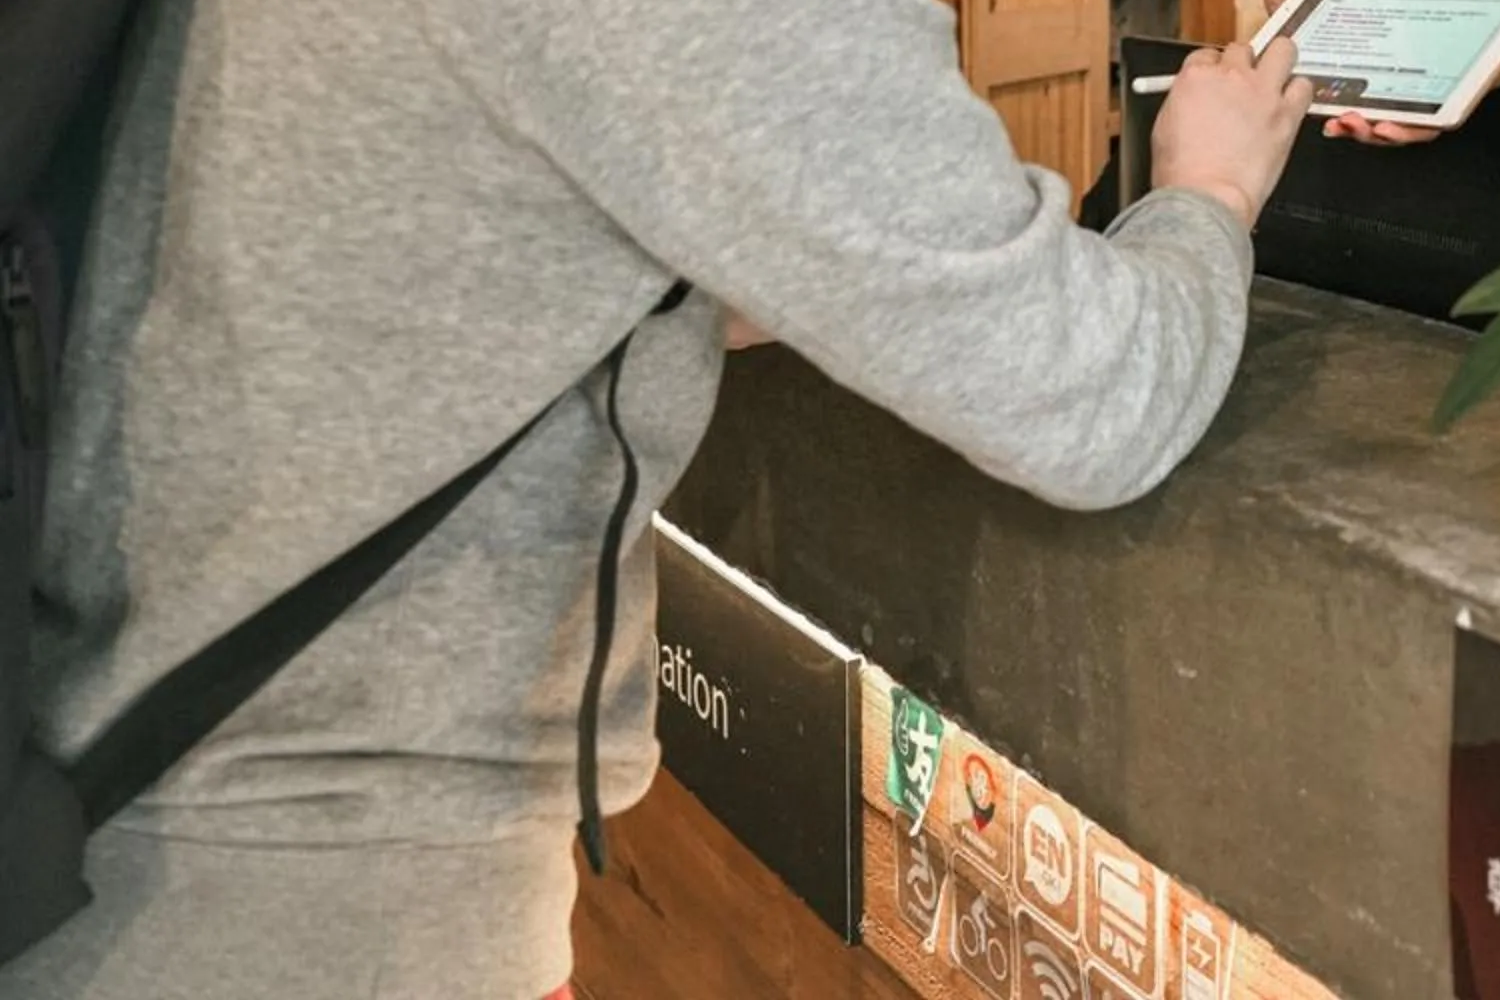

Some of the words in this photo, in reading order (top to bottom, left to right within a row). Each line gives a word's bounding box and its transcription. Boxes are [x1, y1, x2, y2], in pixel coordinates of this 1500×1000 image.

[654, 636, 729, 739] ation
[1031, 821, 1066, 879] EN
[1100, 921, 1146, 975] PAY
